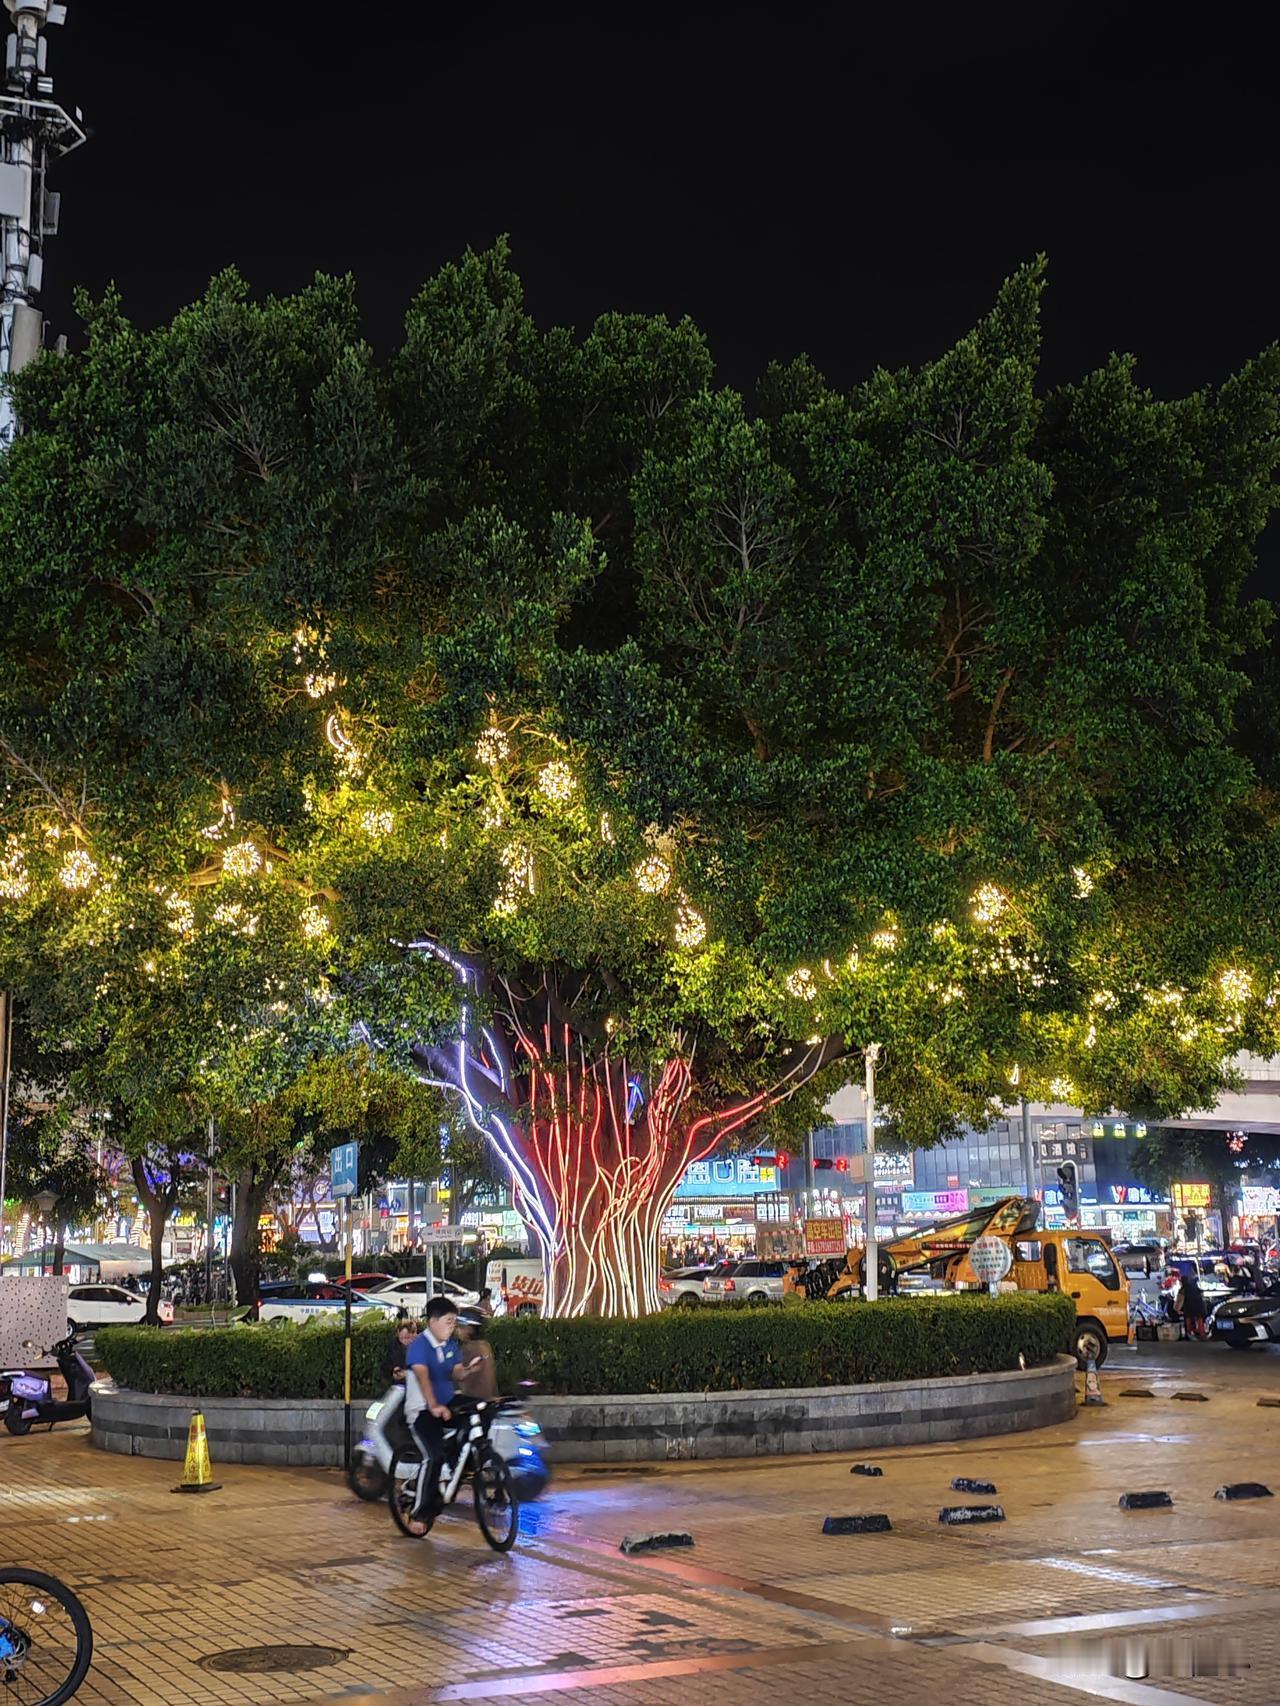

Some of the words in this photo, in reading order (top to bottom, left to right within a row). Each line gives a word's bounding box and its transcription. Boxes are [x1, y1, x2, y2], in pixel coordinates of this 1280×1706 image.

[334, 1146, 354, 1172] 出口
[680, 1159, 759, 1185] 恩口腔
